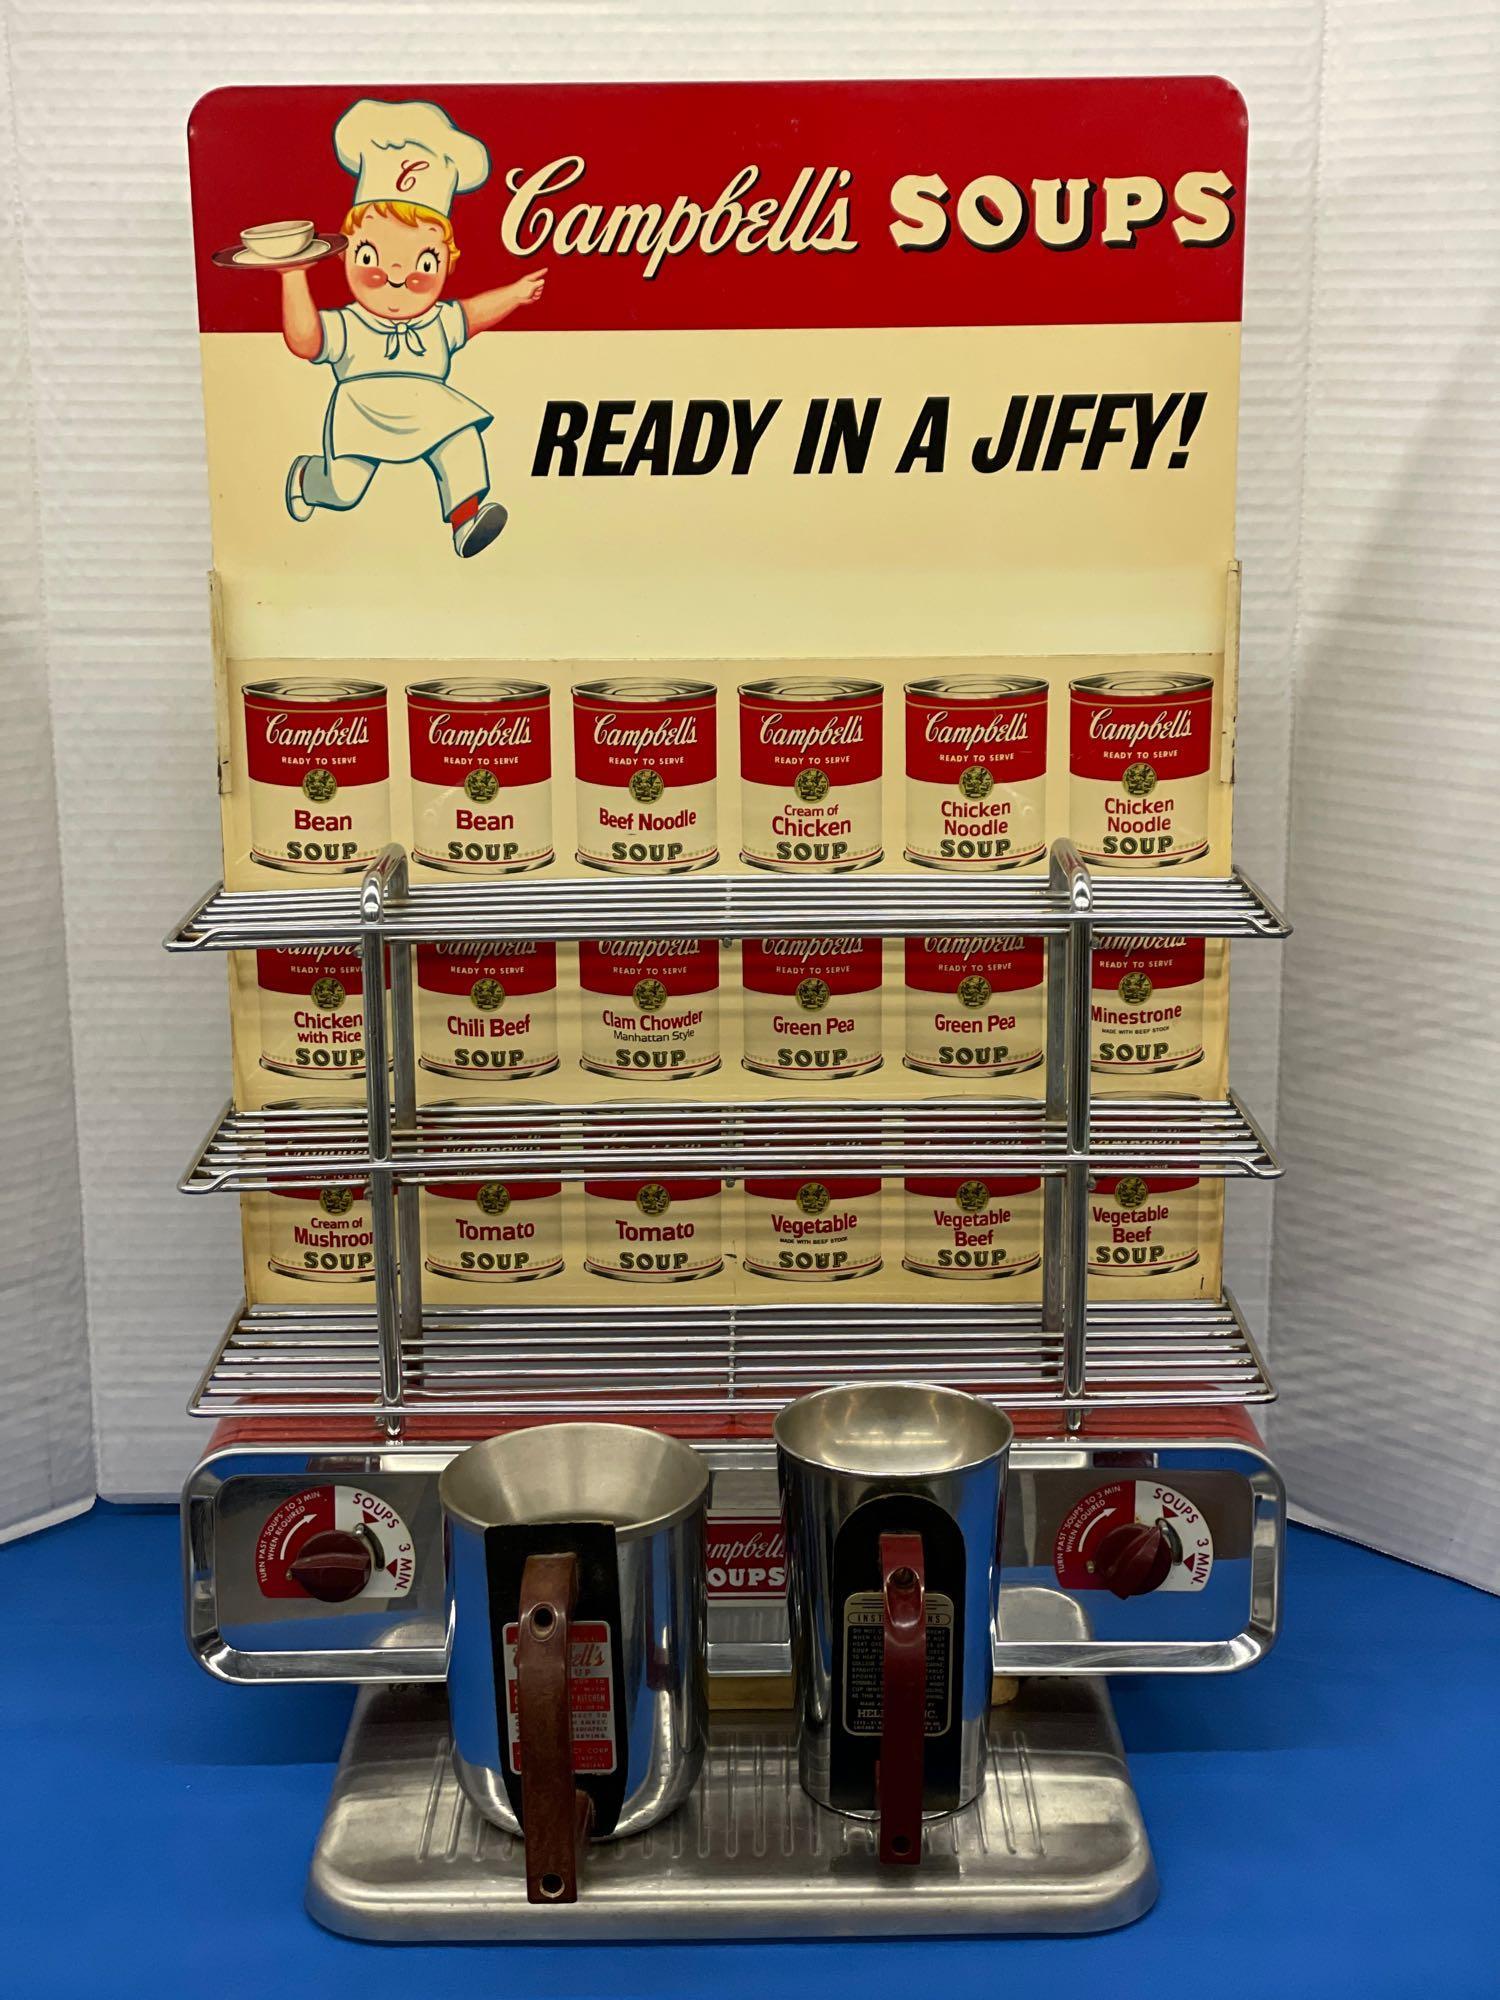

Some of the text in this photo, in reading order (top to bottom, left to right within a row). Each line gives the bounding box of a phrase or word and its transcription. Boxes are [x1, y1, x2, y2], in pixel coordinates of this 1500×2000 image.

[501, 156, 1235, 284] Campbell's SOUPS
[531, 392, 1207, 476] READY IN A JIFFY!
[266, 714, 369, 753] Campbell's
[429, 714, 531, 753] Campbell's
[594, 714, 697, 753] Campbell's
[760, 713, 863, 753] Campbell's
[926, 711, 1028, 750] Campbell's
[1090, 708, 1191, 746] Campbell's
[609, 757, 638, 765] READY
[990, 753, 1014, 761] SERVE
[1154, 750, 1177, 758] SERVE
[785, 804, 838, 816] Cream of
[941, 801, 1010, 818] Chicken
[1105, 798, 1173, 814] Chicken
[295, 810, 352, 831] Bean
[456, 810, 513, 831] Bean
[600, 808, 696, 830] Beef Noodle
[772, 816, 851, 837] Chicken
[945, 819, 1008, 836] Noodle
[1108, 816, 1170, 833] Noodle
[287, 842, 357, 861] SOUP
[448, 842, 518, 861] SOUP
[612, 842, 682, 861] SOUP
[777, 842, 847, 861] SOUP
[941, 839, 1010, 858] SOUP
[1103, 836, 1173, 855] SOUP
[777, 965, 850, 974] READY TO SERVE
[939, 962, 1012, 972] READY TO SERVE
[1132, 960, 1144, 968] TO
[1149, 959, 1172, 967] SERVE
[294, 1011, 363, 1029] Chicken
[603, 1010, 703, 1031] Clam Chowder
[935, 1014, 1015, 1033] Green Pea
[1091, 1005, 1182, 1025] Minestrone
[447, 1014, 530, 1037] Chili Beef
[774, 1016, 854, 1035] Green Pea
[298, 1031, 361, 1043] with Rice
[614, 1029, 694, 1042] Manhattan Style
[296, 1048, 365, 1067] SOUP
[455, 1049, 524, 1067] SOUP
[616, 1049, 685, 1067] SOUP
[778, 1049, 847, 1067] SOUP
[939, 1046, 1008, 1065] SOUP
[1100, 1043, 1168, 1061] SOUP
[311, 1217, 362, 1229] Cream of
[771, 1213, 857, 1238] Vegetable
[934, 1205, 1011, 1231] Vegetable
[1093, 1205, 1168, 1227] Vegetable
[294, 1226, 373, 1248] Mushroo
[456, 1219, 534, 1240] Tomato
[616, 1220, 694, 1241] Tomato
[954, 1226, 994, 1246] Beef
[1113, 1226, 1152, 1243] Beef
[303, 1251, 373, 1270] SOUP
[461, 1252, 529, 1270] SOUP
[620, 1252, 688, 1270] SOUP
[779, 1251, 847, 1269] SOUP
[937, 1248, 1007, 1267] SOUP
[1096, 1246, 1164, 1264] SOUP
[285, 1502, 296, 1513] TO
[1085, 1496, 1096, 1506] TO
[1153, 1488, 1198, 1524] SOUPS
[353, 1493, 399, 1529] SOUPS
[267, 1505, 306, 1561] WHEN REQUIRED
[1066, 1499, 1106, 1553] WHEN REQUIRED
[259, 1540, 267, 1559] PAST
[1057, 1532, 1067, 1551] PAST
[258, 1560, 267, 1582] TURN
[1057, 1552, 1065, 1574] TURN
[1191, 1538, 1209, 1585] 3 MIN.
[394, 1558, 412, 1590] MIN.
[707, 1567, 785, 1587] OUPS
